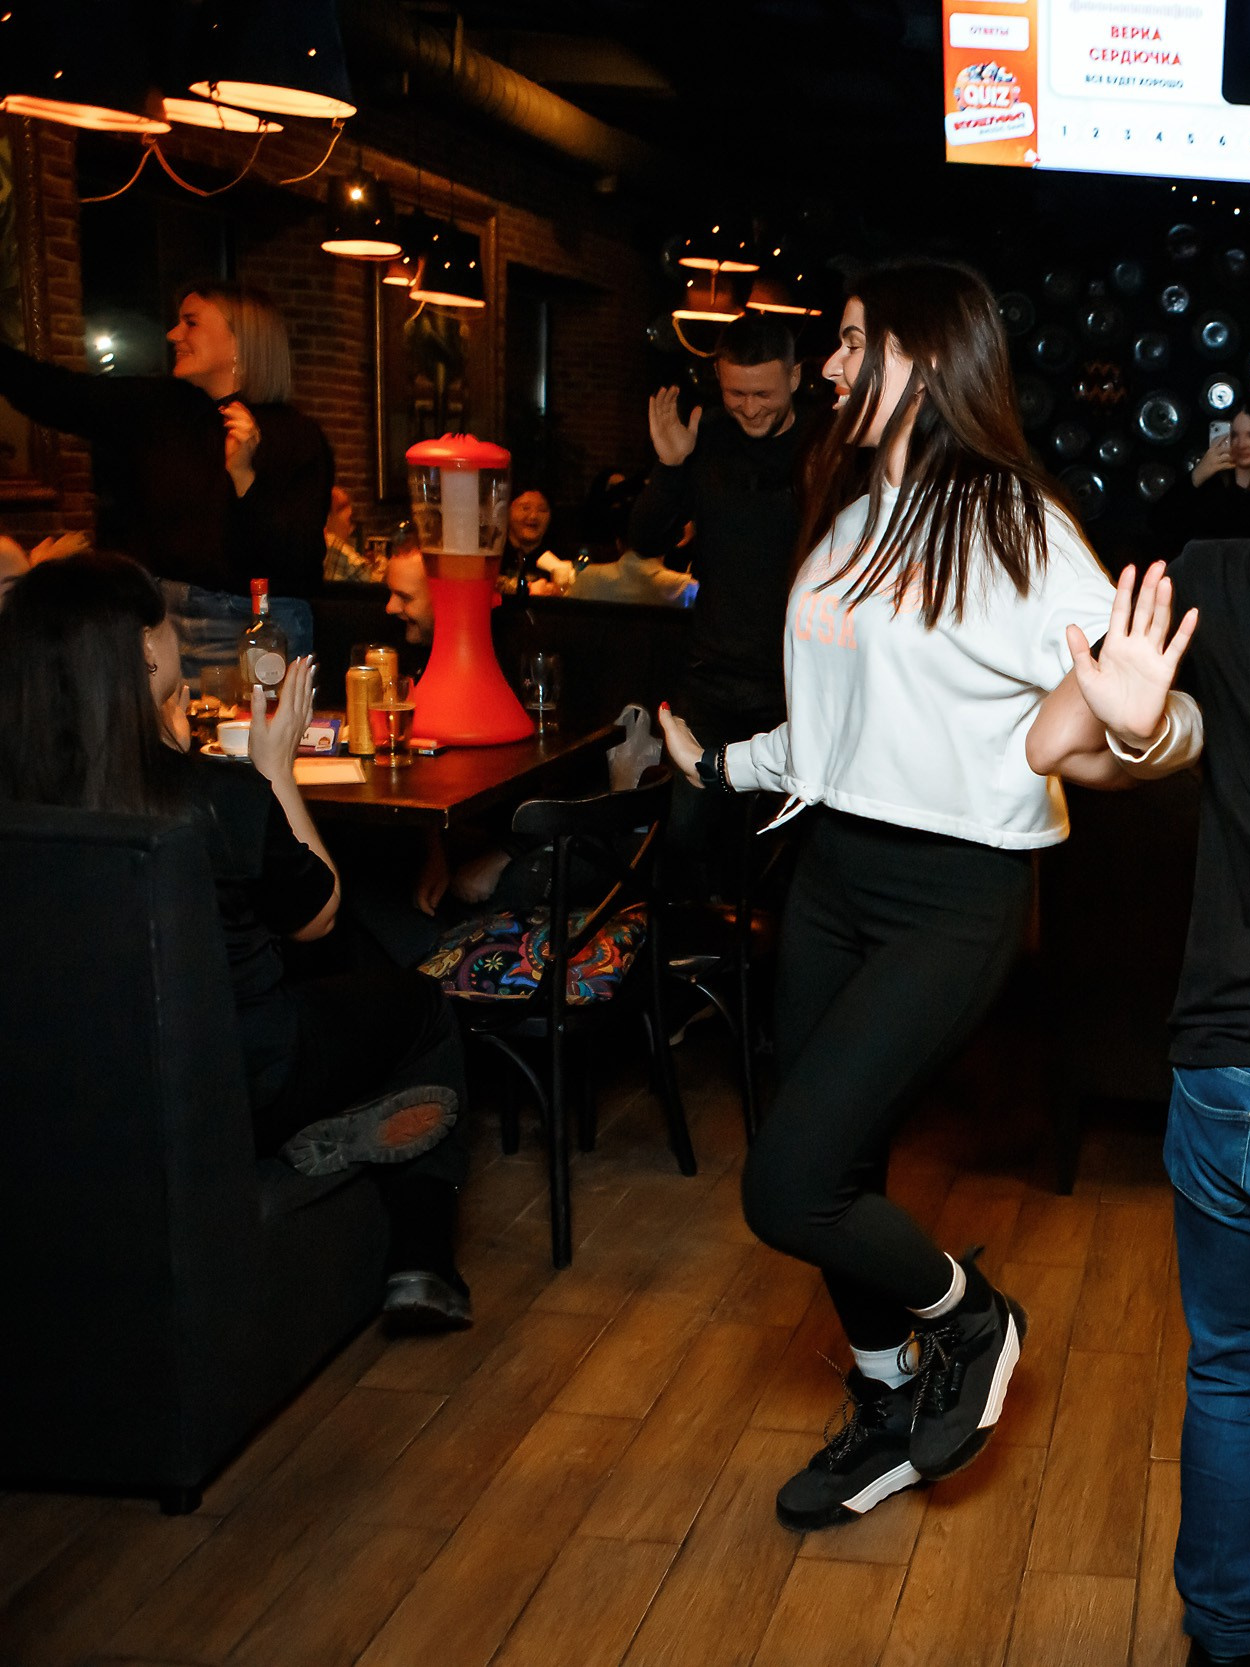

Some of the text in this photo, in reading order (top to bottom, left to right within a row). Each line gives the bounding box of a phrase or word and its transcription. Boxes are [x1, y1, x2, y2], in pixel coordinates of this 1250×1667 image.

[1110, 25, 1162, 41] ВЕРКА
[1089, 47, 1182, 65] СЕРДЮЧКА
[963, 84, 1010, 107] QUIZ
[1093, 127, 1099, 138] 2
[1125, 129, 1131, 140] 3
[1156, 131, 1163, 142] 4
[1188, 133, 1195, 144] 5
[1219, 135, 1226, 146] 6
[795, 591, 858, 650] USA
